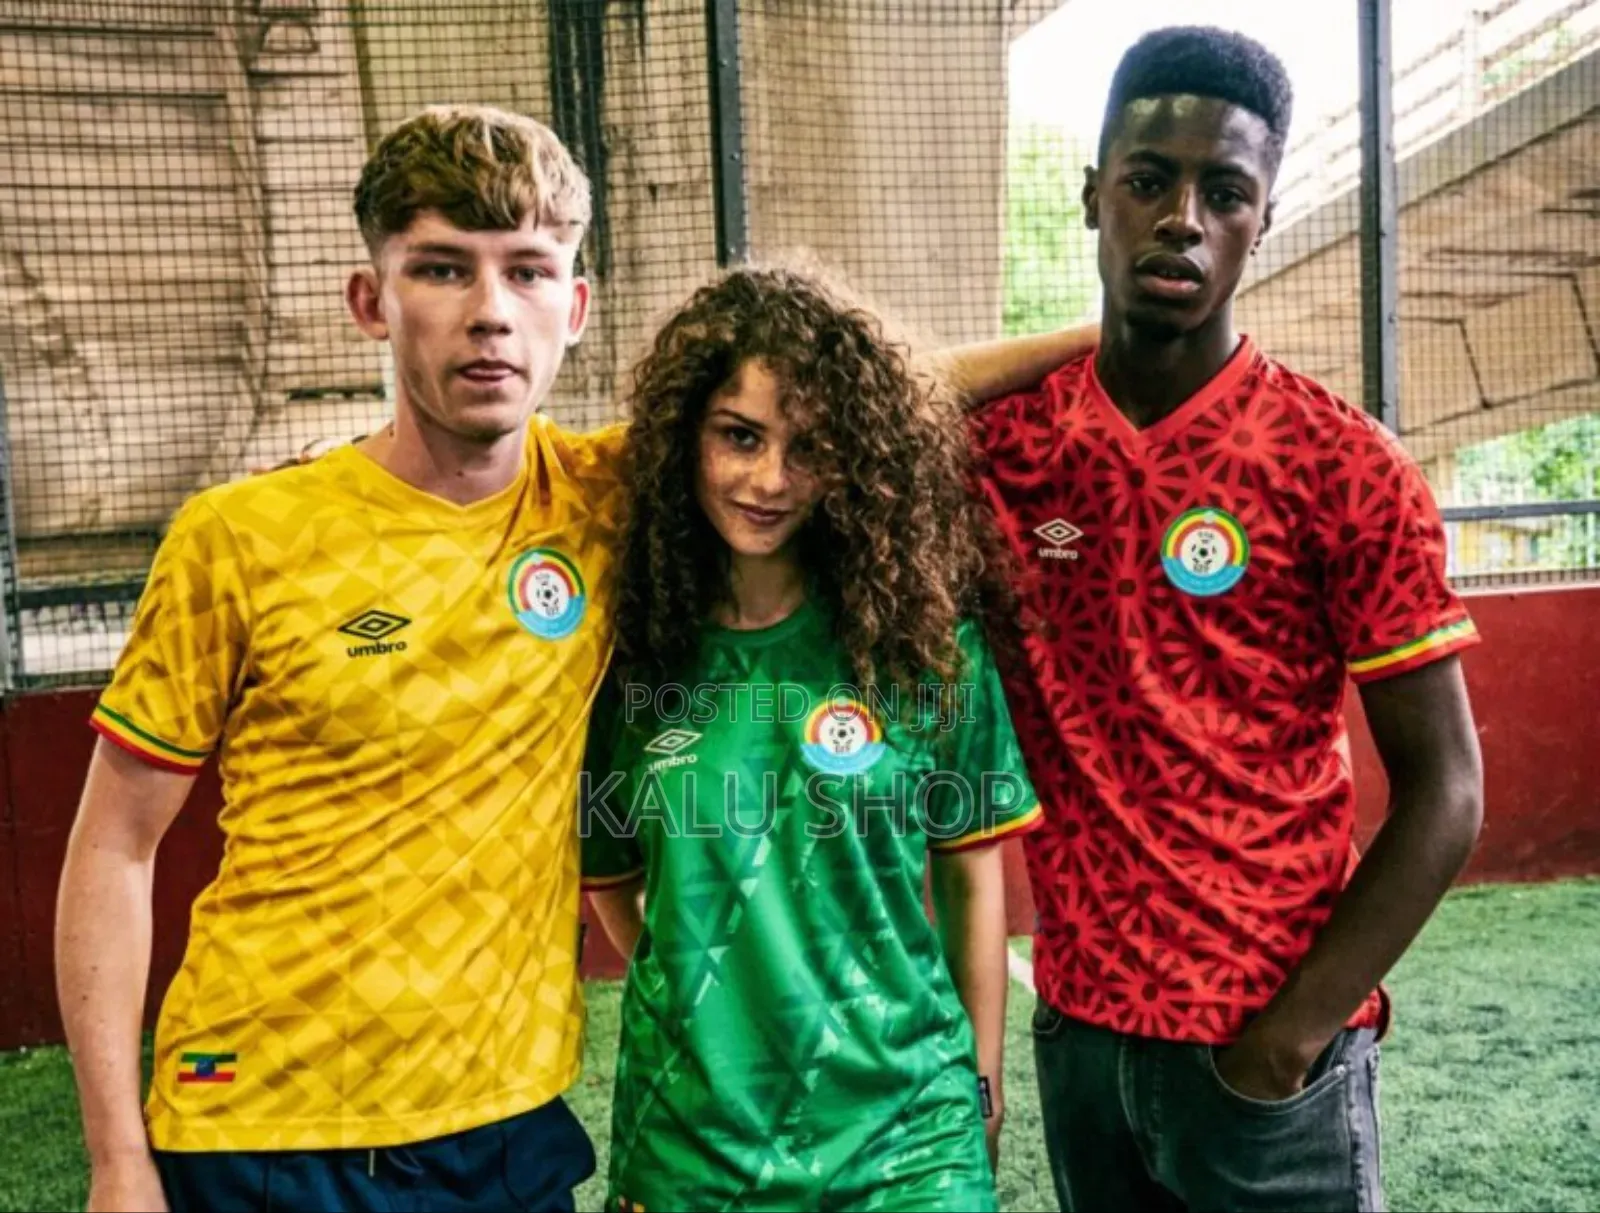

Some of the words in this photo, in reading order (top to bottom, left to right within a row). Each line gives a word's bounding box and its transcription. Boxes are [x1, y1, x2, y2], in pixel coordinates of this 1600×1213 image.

[1037, 546, 1079, 560] umbro
[346, 640, 408, 658] umbro
[648, 754, 698, 771] umbro
